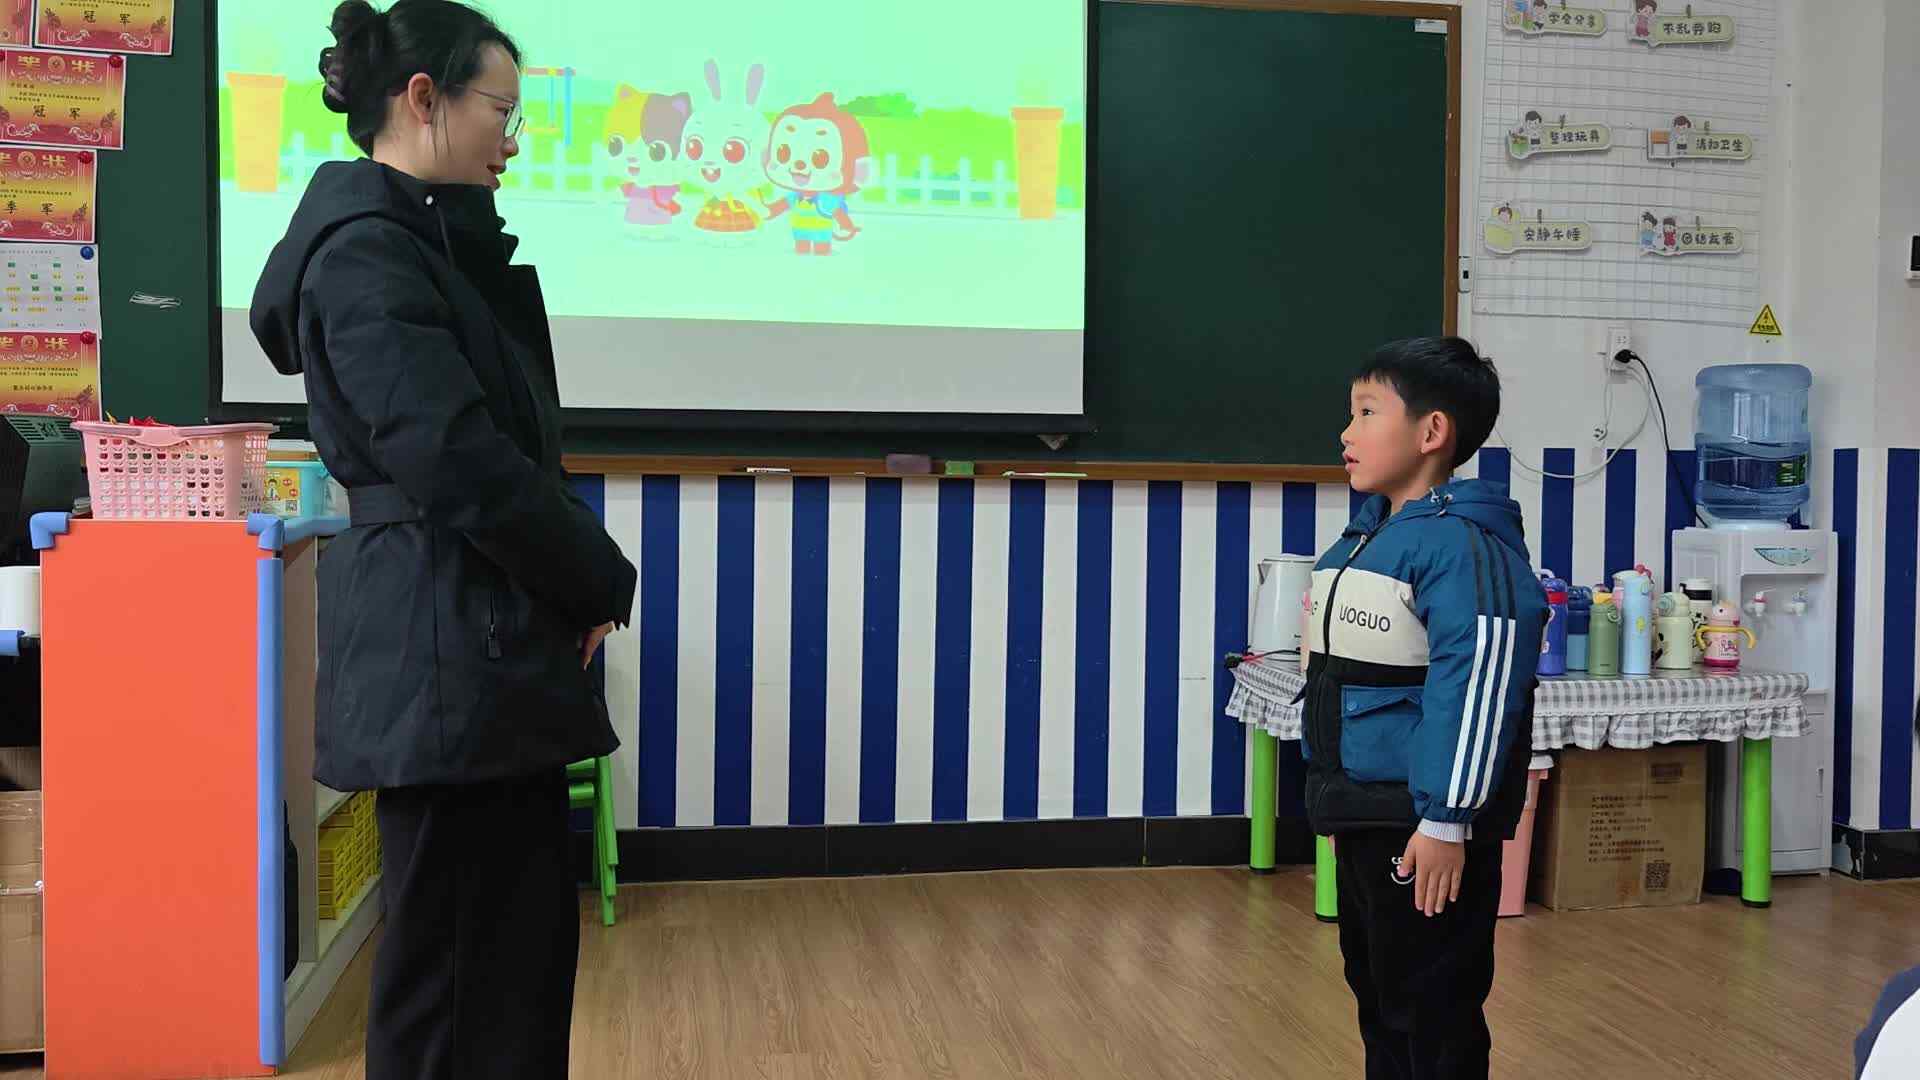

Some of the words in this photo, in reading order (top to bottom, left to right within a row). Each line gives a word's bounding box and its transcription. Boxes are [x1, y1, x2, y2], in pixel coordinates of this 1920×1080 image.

[84, 10, 97, 23] 冠
[120, 13, 131, 25] 军
[33, 105, 46, 117] 冠
[69, 107, 80, 120] 军
[1550, 129, 1600, 145] 整理玩具
[1696, 138, 1743, 152] 清扫卫生
[1524, 226, 1582, 241] 安静午睡
[1339, 605, 1391, 632] UOGUO
